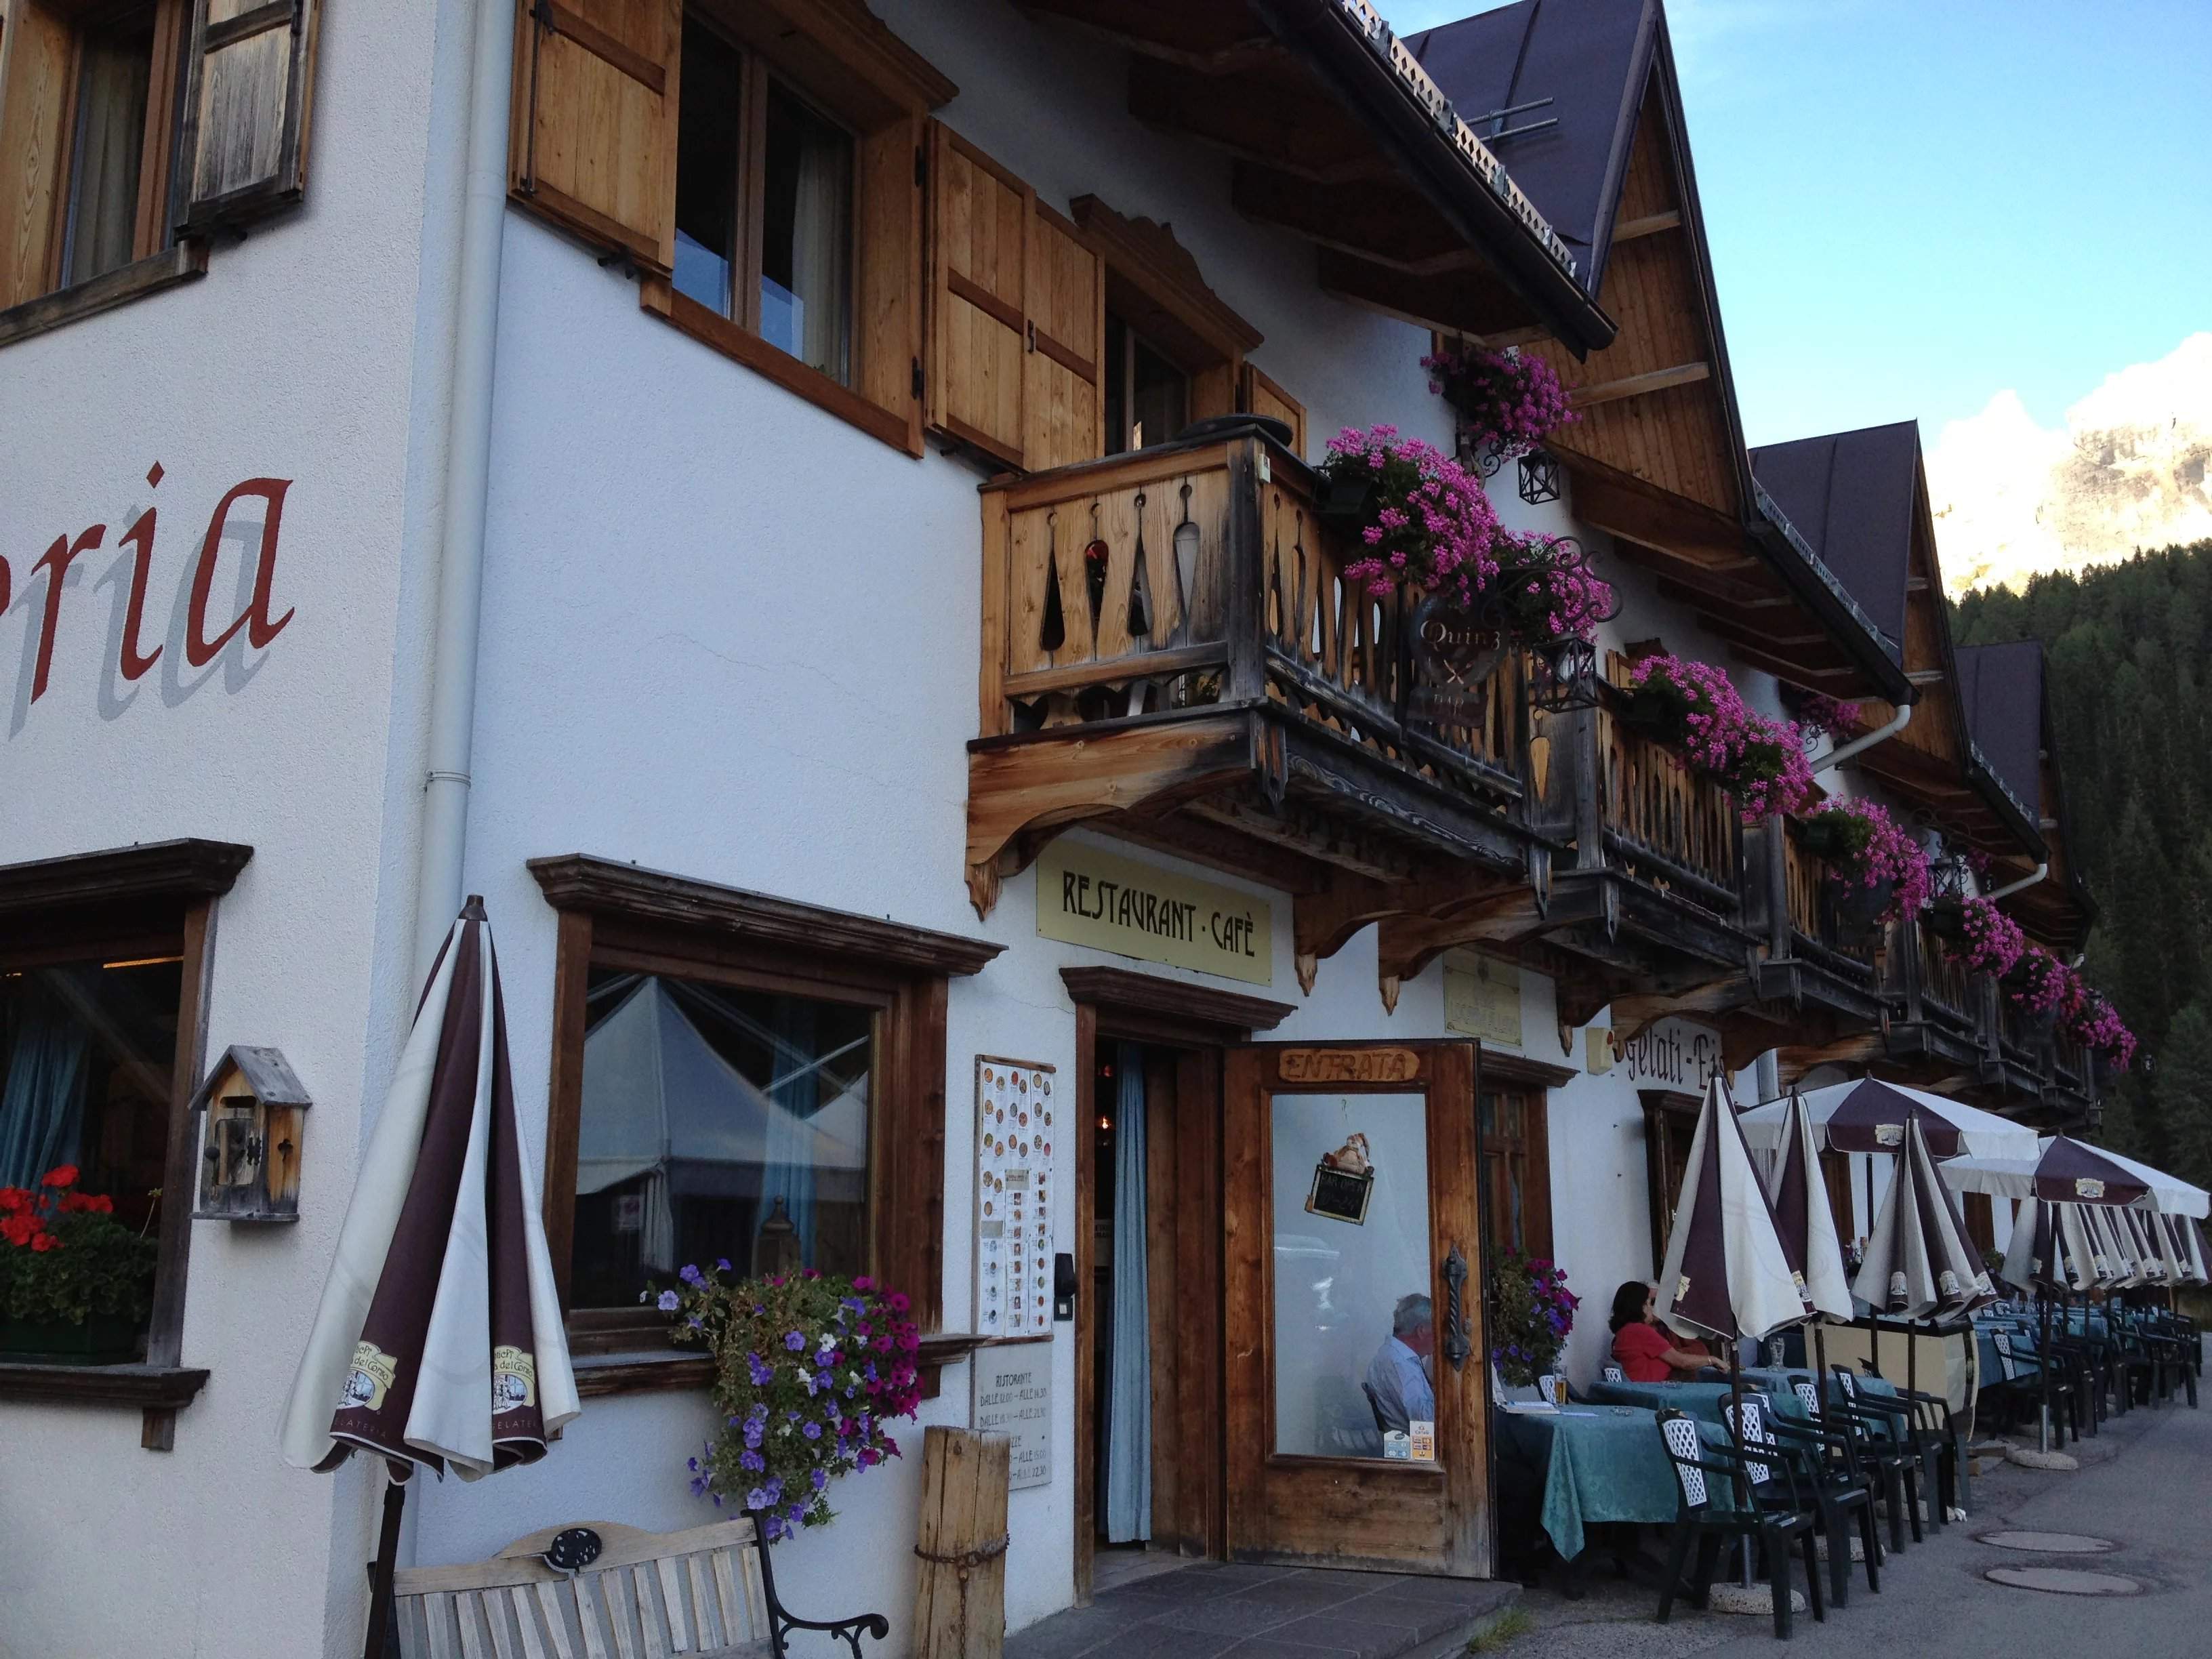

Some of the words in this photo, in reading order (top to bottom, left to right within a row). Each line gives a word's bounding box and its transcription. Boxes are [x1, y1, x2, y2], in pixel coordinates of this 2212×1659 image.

[1063, 869, 1197, 943] RESTAURANT
[1211, 912, 1255, 958] CAFÈ
[1286, 1051, 1406, 1080] ENTRATA
[996, 1372, 1032, 1387] RISTORANTE
[981, 1393, 999, 1407] DALLE
[1019, 1388, 1033, 1400] ALLE
[980, 1414, 999, 1428] DALLE
[1019, 1450, 1033, 1463] ALLE
